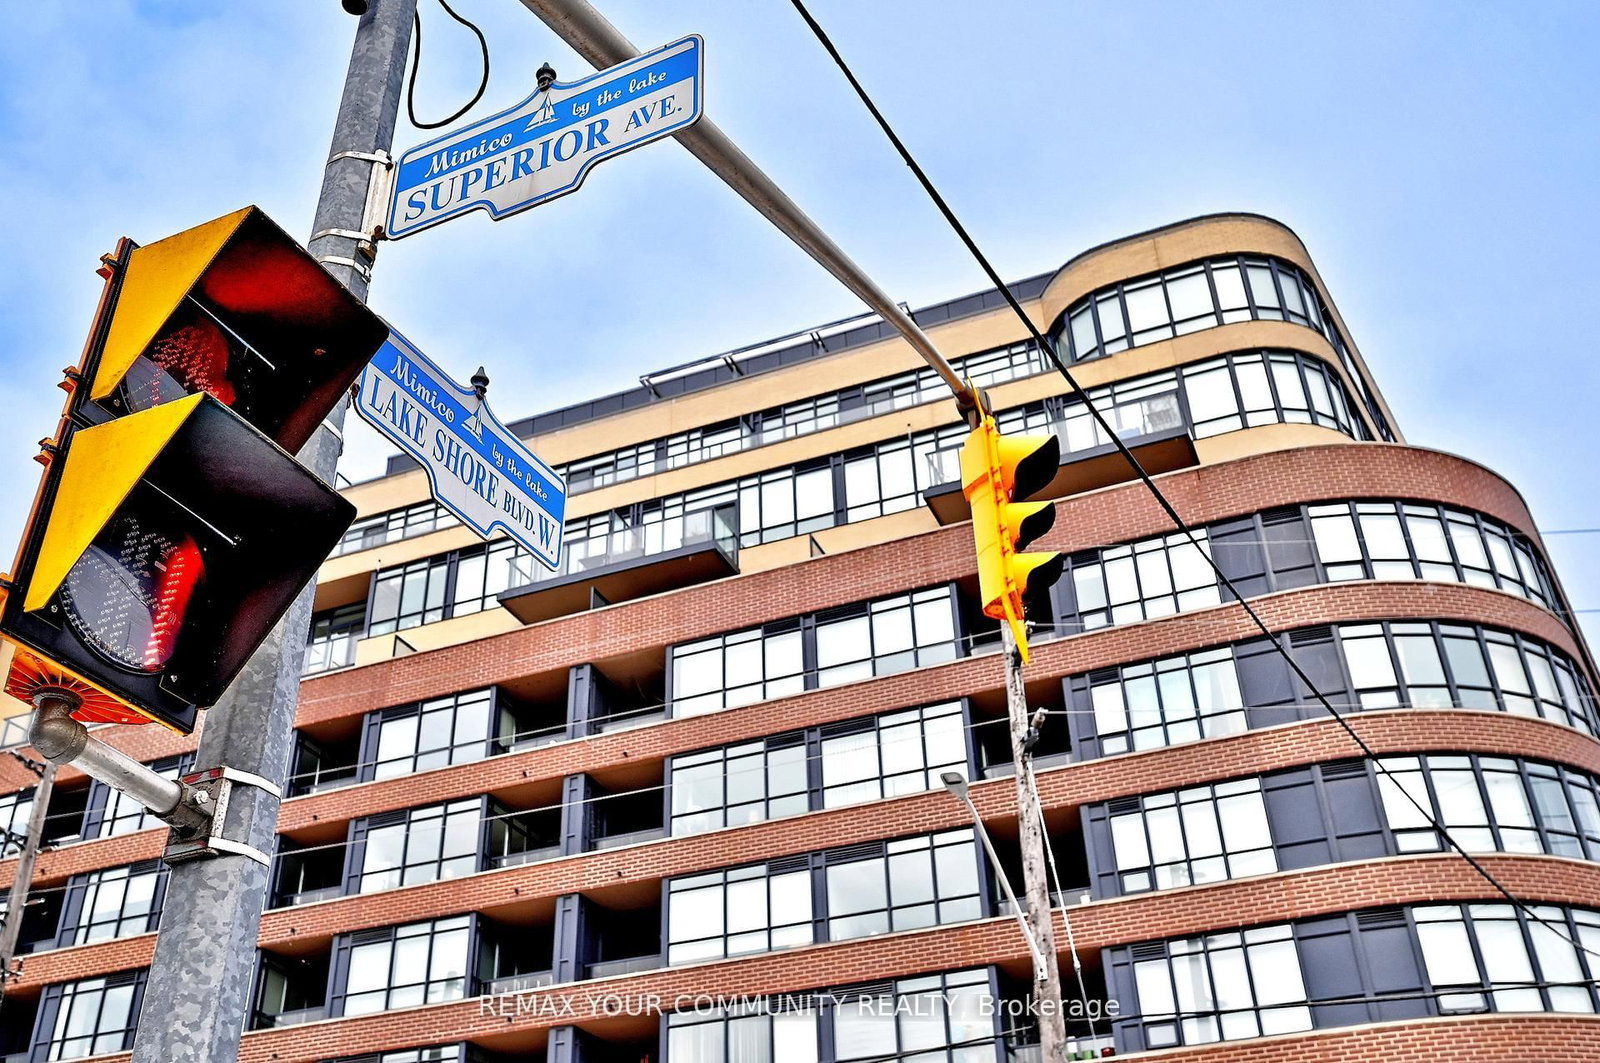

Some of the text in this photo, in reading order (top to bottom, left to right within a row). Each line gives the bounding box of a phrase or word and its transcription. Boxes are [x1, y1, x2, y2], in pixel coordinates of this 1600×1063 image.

[404, 94, 683, 223] SUPERIOR AVE.
[424, 71, 667, 178] Mimico by the lake
[368, 374, 429, 448] LAKE
[432, 428, 500, 508] SHORE
[503, 489, 536, 535] BLVD.
[390, 355, 549, 502] Mimico by the lake
